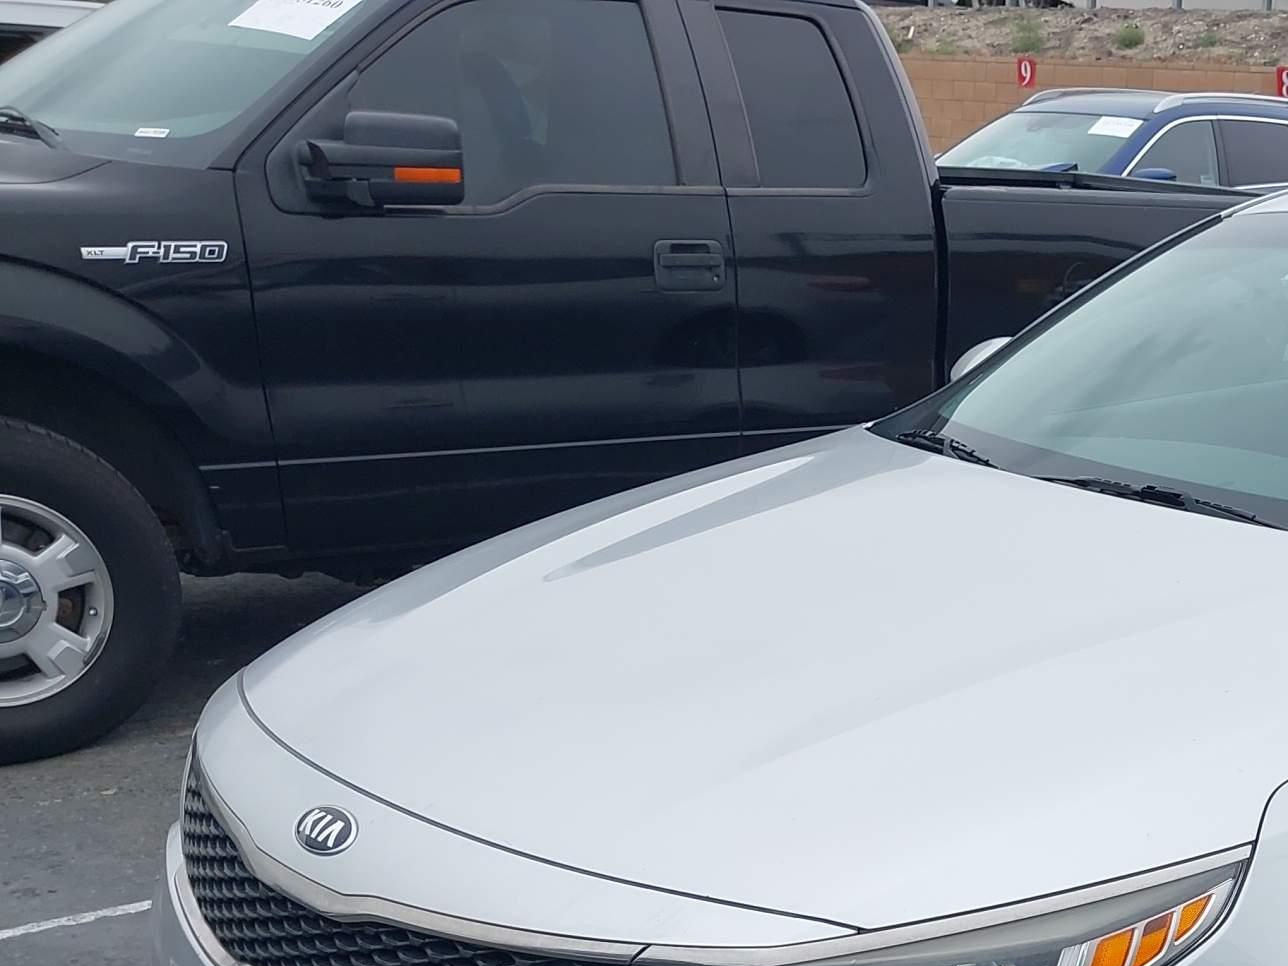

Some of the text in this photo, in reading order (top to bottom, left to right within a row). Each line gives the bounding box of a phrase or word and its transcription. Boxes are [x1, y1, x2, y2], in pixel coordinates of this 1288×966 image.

[1020, 60, 1032, 86] 9
[125, 241, 228, 263] F-150
[298, 808, 346, 848] KIA
